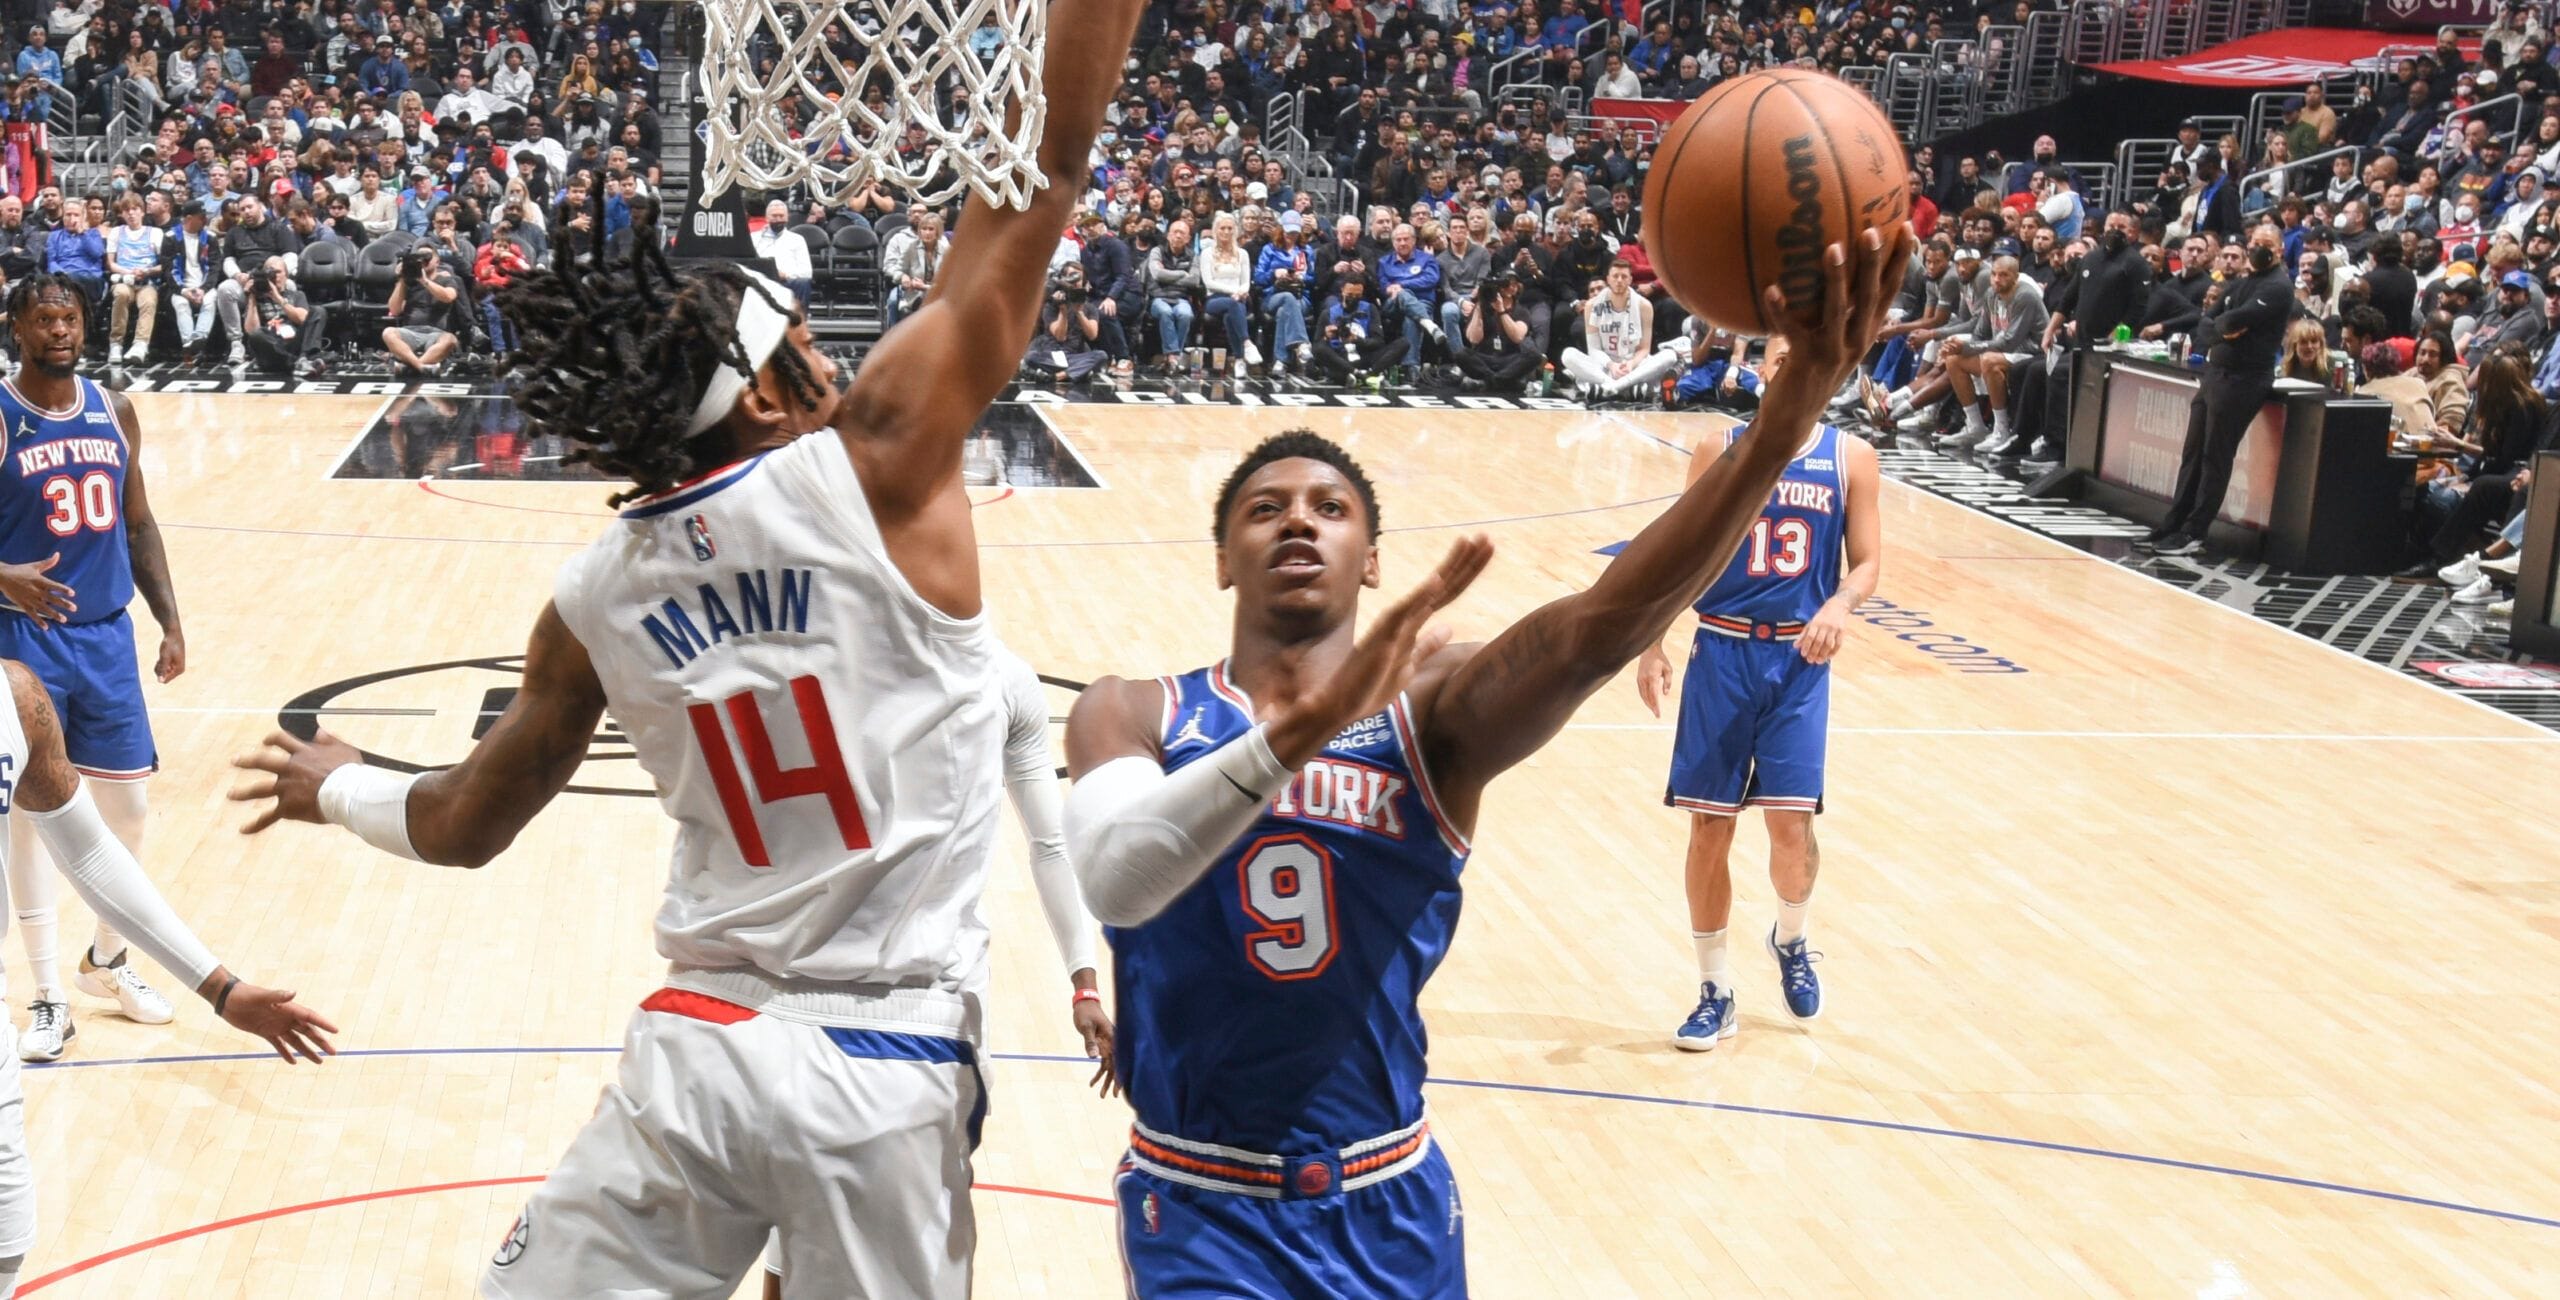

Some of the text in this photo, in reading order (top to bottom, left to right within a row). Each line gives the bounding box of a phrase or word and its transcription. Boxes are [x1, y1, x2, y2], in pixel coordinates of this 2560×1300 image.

[693, 211, 734, 237] @NBA
[1608, 336, 1618, 351] 5
[88, 379, 472, 396] IPPERS
[1014, 390, 1587, 411] A CLIPPERS
[17, 437, 121, 478] NEW YORK
[42, 470, 117, 537] 30
[1776, 480, 1834, 515] YORK
[1747, 517, 1812, 577] 13
[641, 568, 811, 669] MANN
[1852, 596, 2029, 673] to.com
[1329, 732, 1377, 750] PACE
[1340, 714, 1389, 736] UARE
[688, 675, 871, 866] 14
[1237, 831, 1340, 982] 9
